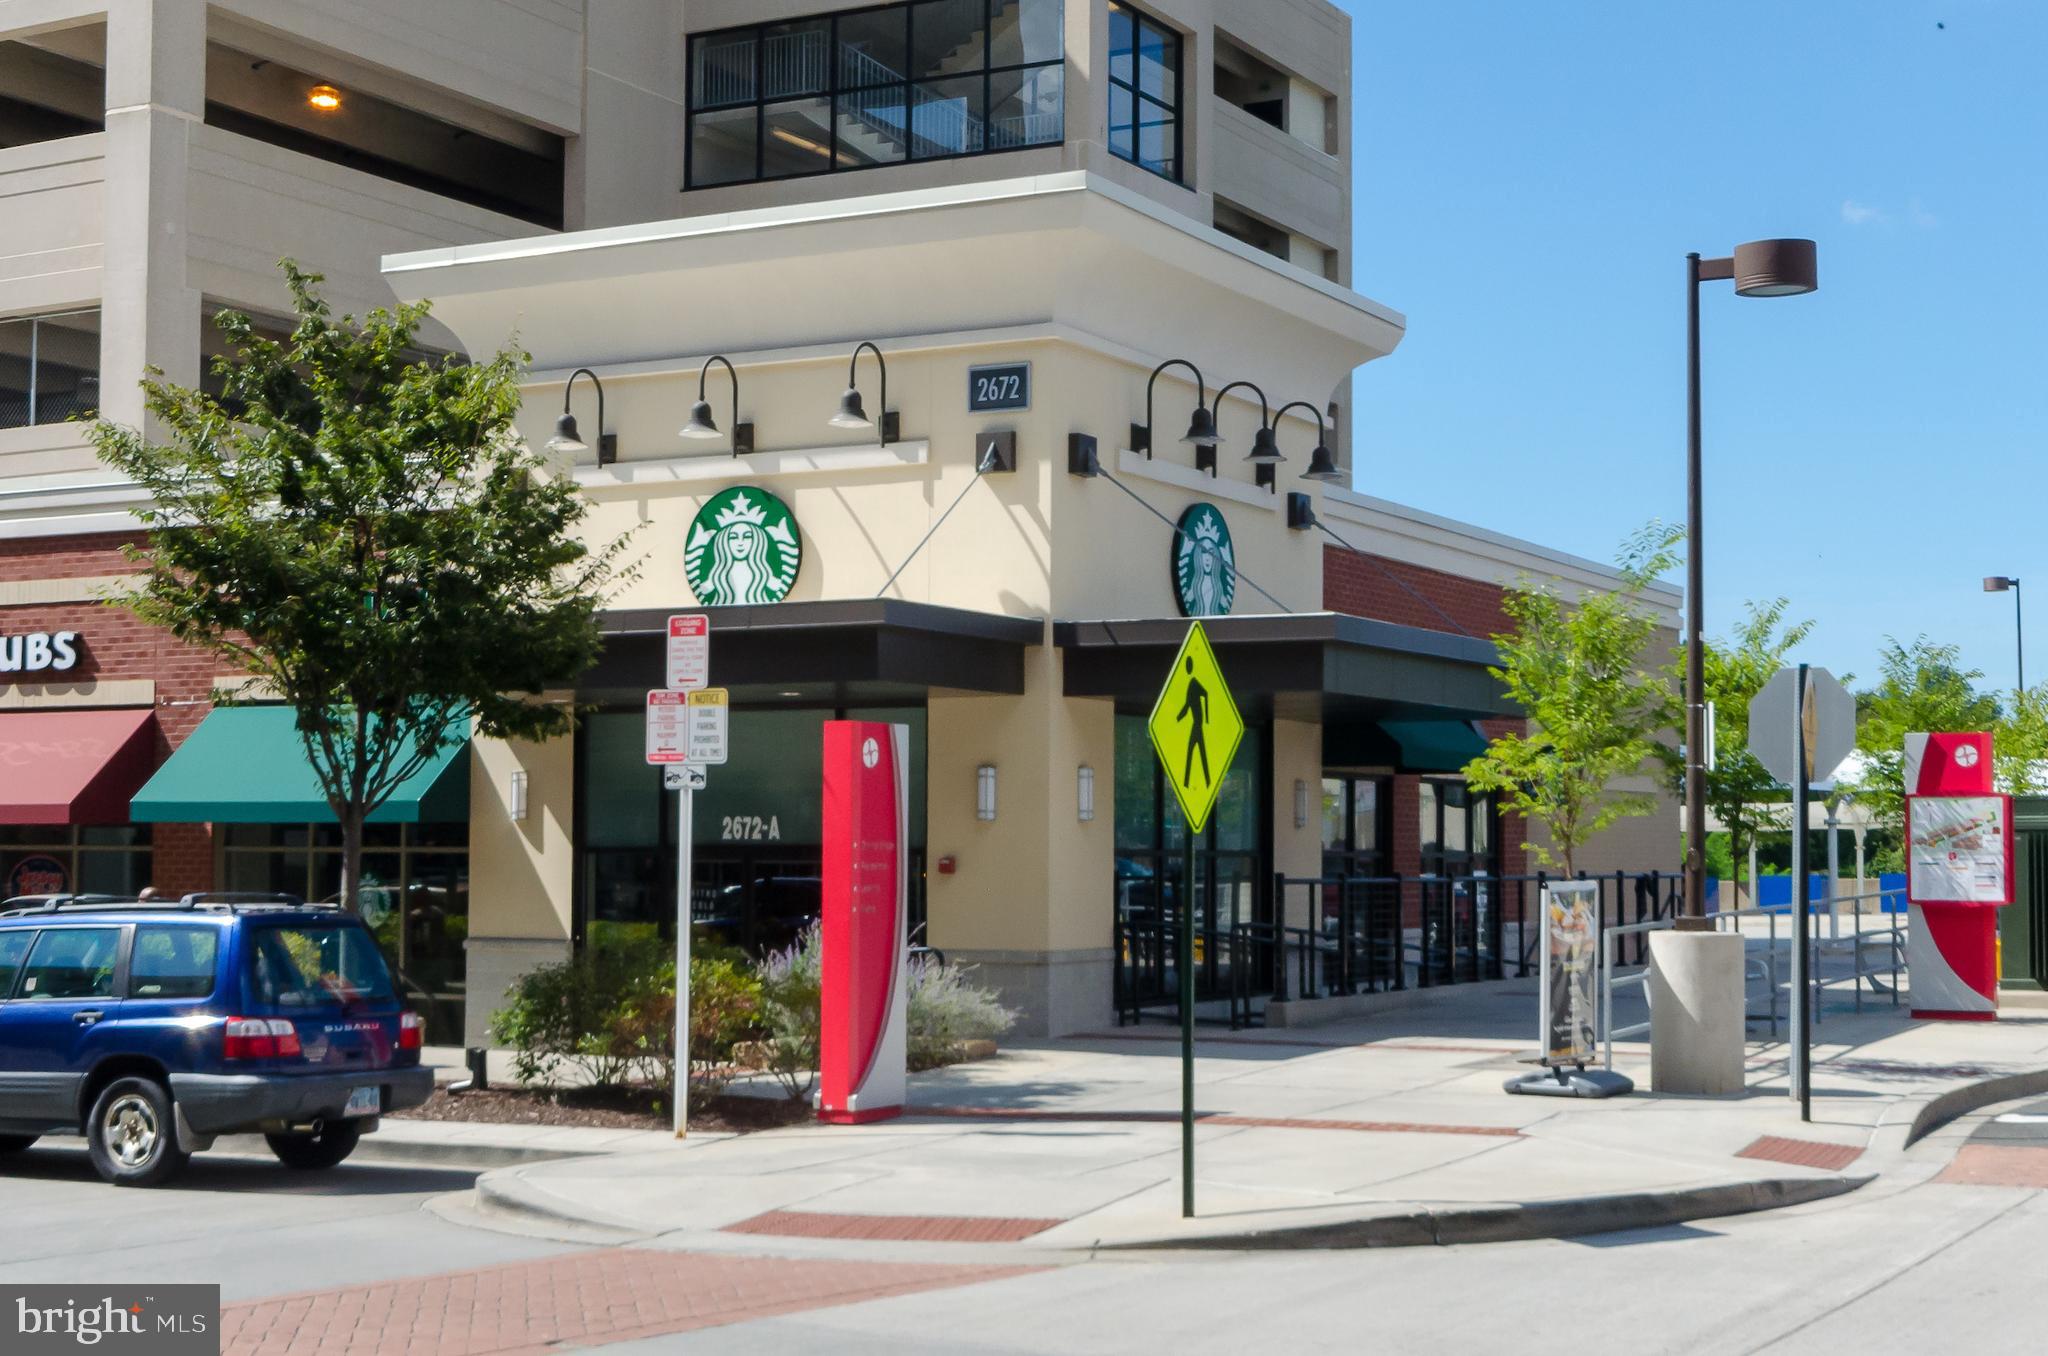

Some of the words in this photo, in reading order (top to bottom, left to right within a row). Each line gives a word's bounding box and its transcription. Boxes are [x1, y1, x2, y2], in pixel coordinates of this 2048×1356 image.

[977, 375, 1020, 402] 2672
[695, 693, 720, 704] NOTICE
[698, 708, 716, 717] DOUBLE
[696, 722, 717, 730] PARKING
[693, 735, 720, 743] PROHIBITED
[722, 815, 780, 840] 2672-A
[324, 1023, 380, 1032] SUBARU
